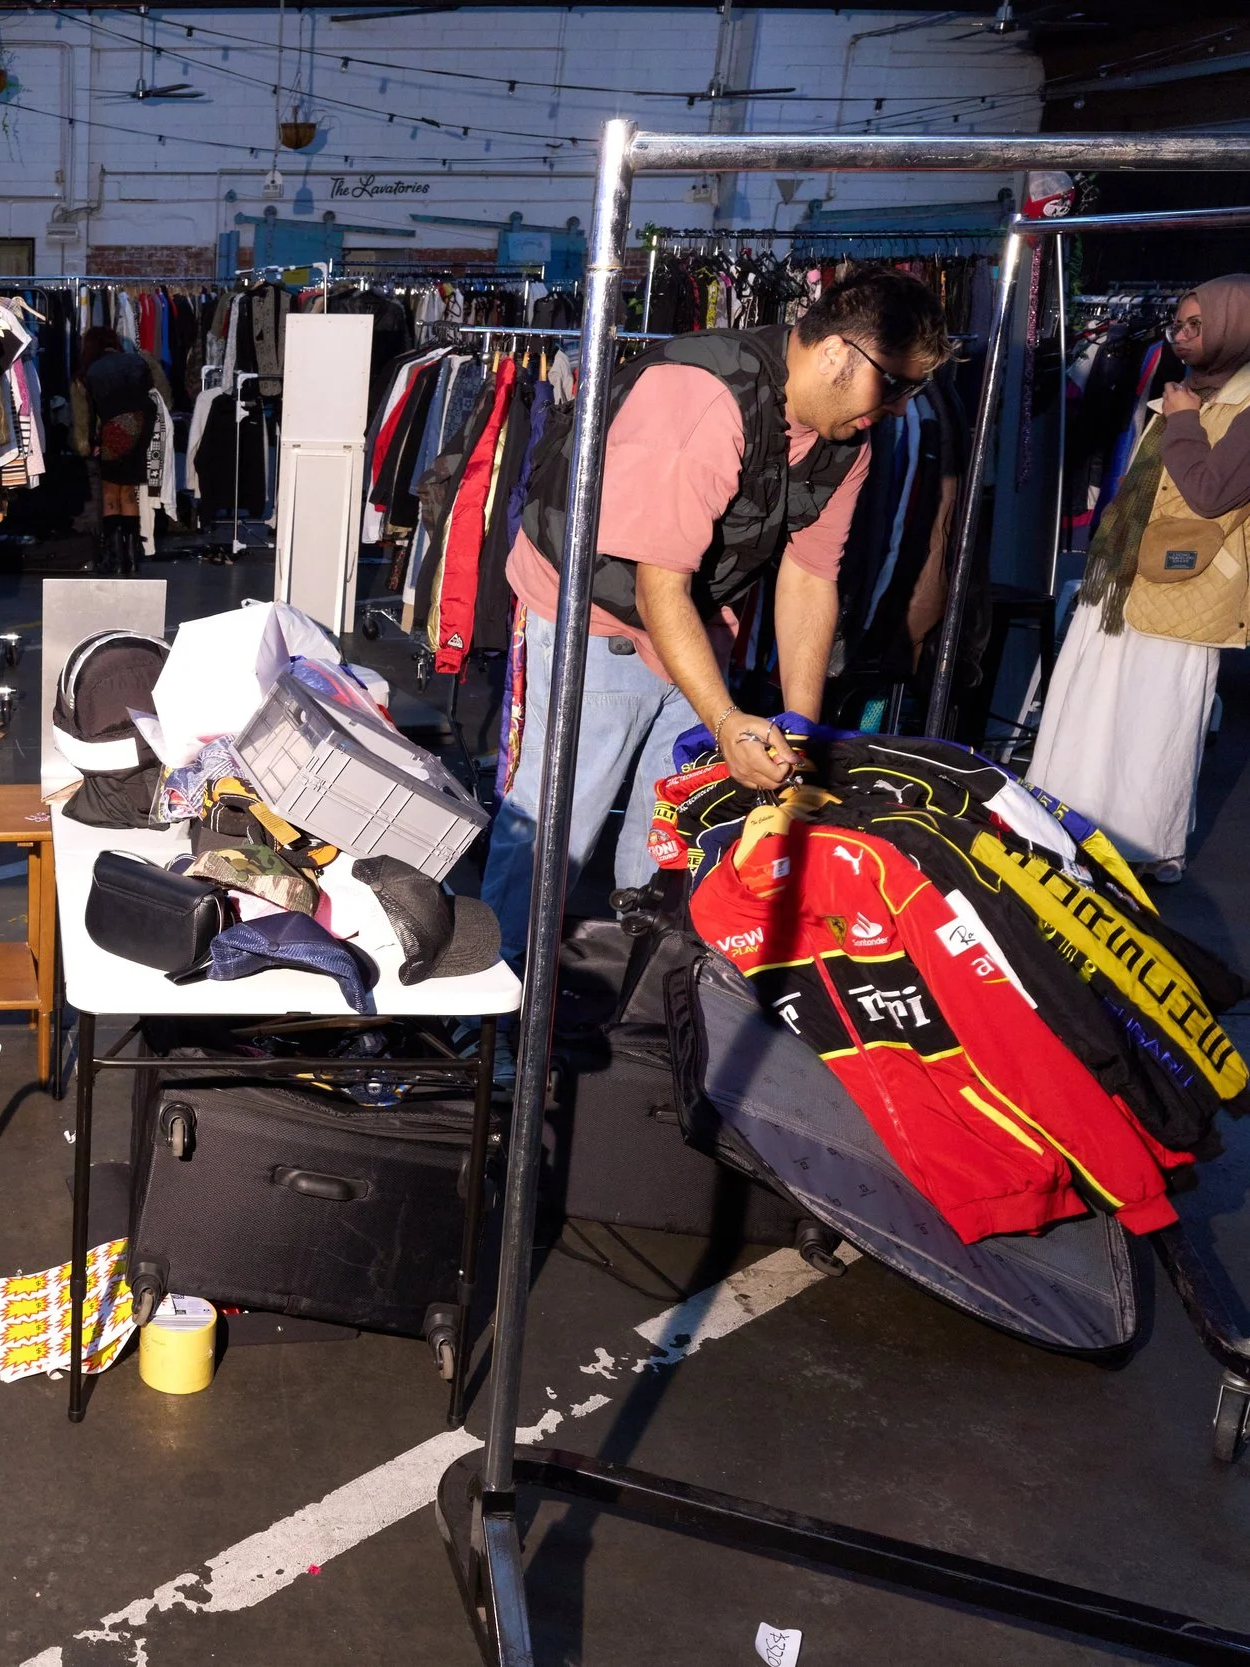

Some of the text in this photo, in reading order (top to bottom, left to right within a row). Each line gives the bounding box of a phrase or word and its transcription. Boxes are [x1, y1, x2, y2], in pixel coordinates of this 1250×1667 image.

[330, 174, 430, 199] The Lavatories
[717, 926, 764, 951] VGW
[851, 936, 889, 947] Santander
[732, 944, 759, 957] PLAY
